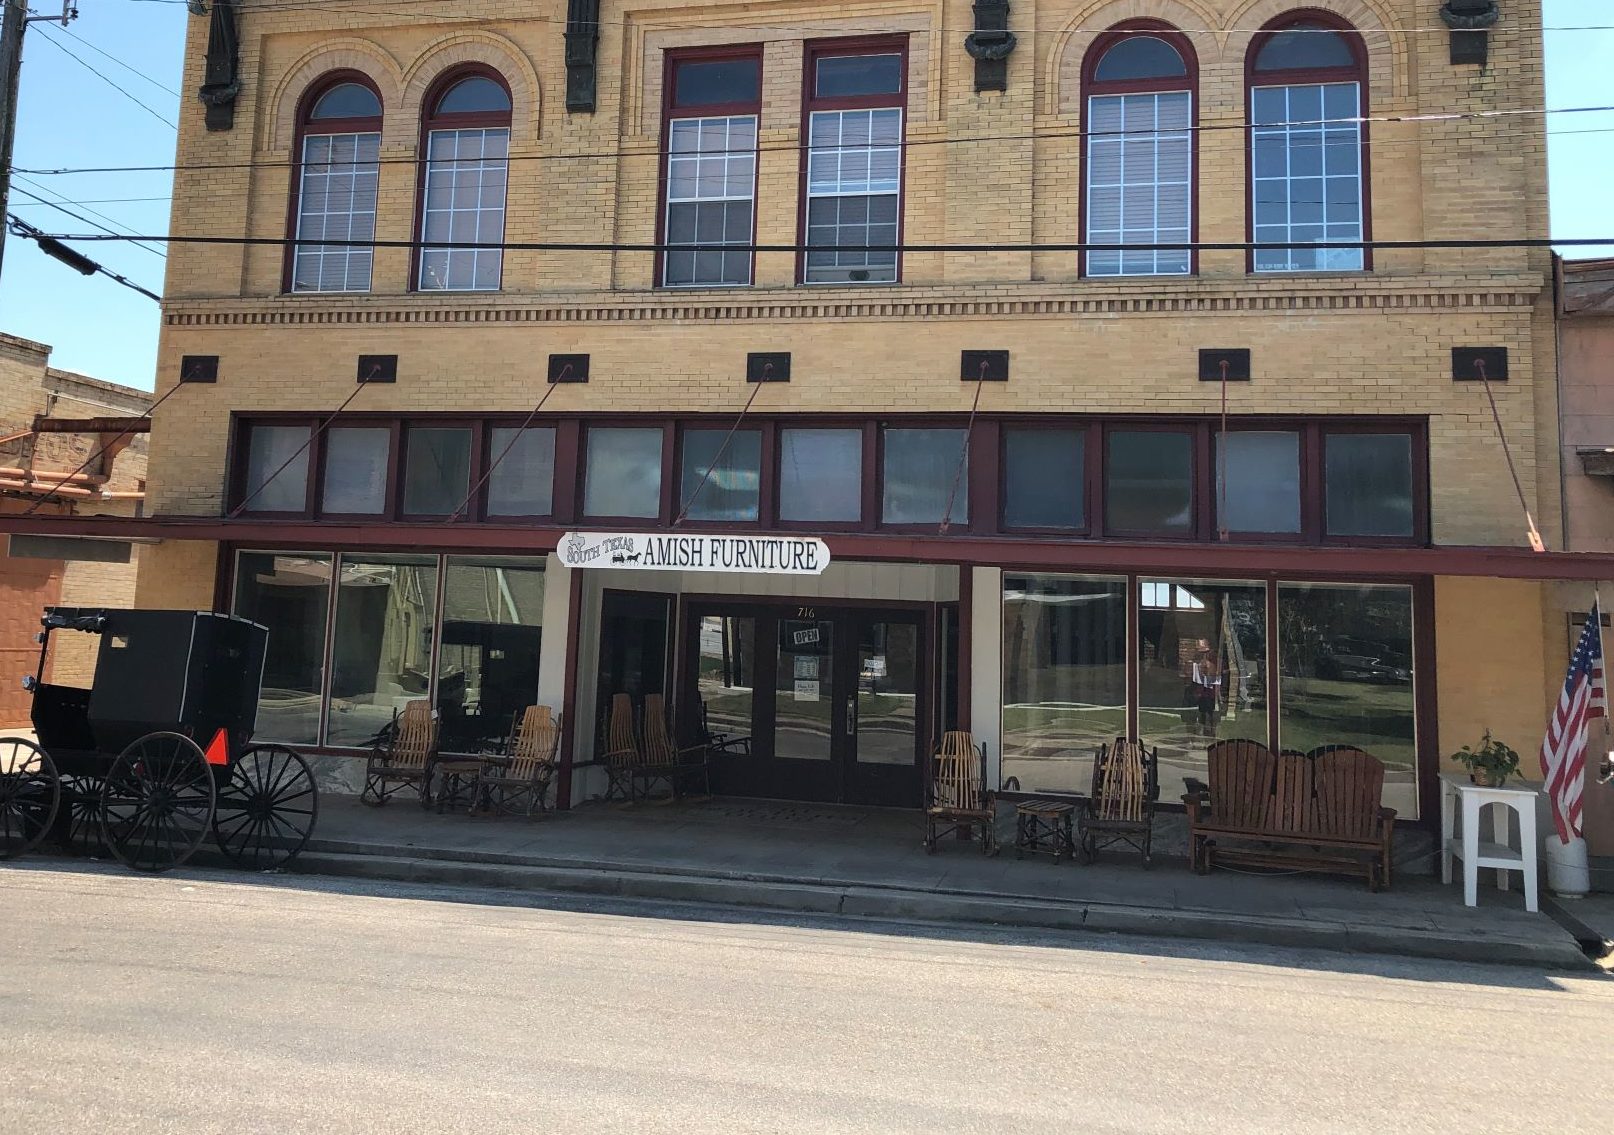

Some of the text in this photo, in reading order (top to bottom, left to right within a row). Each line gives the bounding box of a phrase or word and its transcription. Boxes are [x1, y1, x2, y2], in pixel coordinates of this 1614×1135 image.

[567, 536, 634, 564] SOUTH TEXAS
[643, 537, 818, 571] AMISH FURNITURE
[798, 607, 815, 618] 716
[796, 630, 818, 643] OPEN
